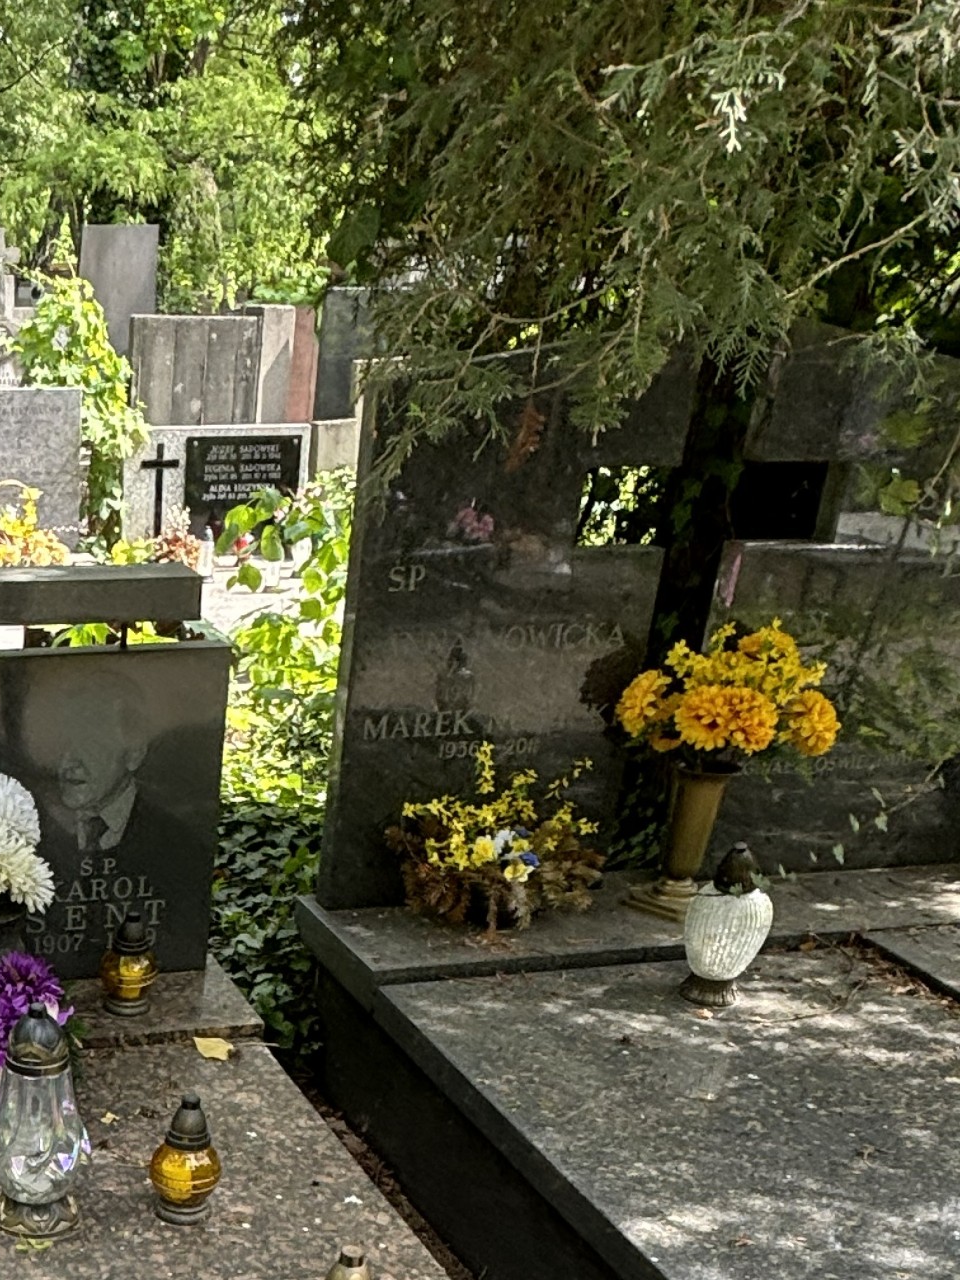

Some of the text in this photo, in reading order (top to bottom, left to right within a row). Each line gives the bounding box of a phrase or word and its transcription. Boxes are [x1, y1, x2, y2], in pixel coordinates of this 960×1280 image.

[362, 709, 478, 741] MAREK
[26, 898, 167, 936] SENT
[33, 932, 86, 956] 1907
[106, 926, 158, 951] 19
